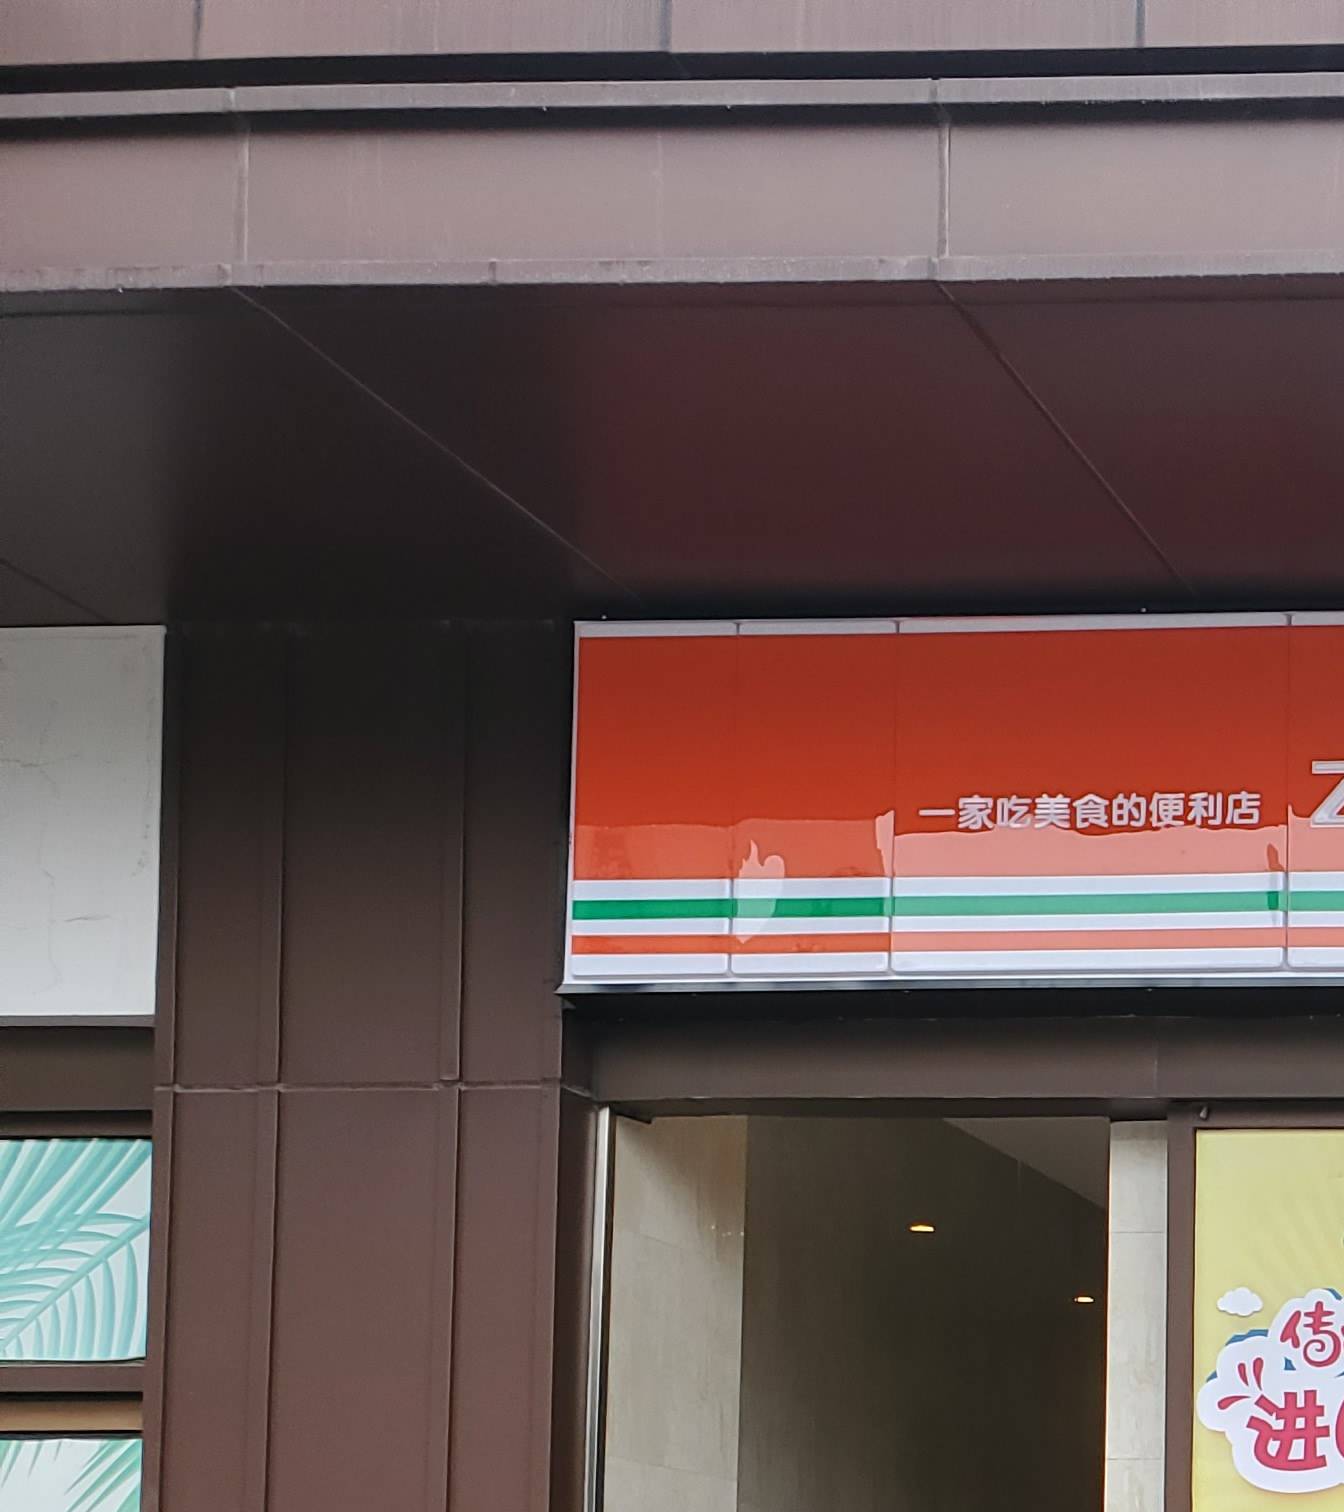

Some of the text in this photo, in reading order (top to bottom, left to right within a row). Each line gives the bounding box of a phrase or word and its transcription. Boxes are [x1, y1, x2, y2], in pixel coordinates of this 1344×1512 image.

[918, 791, 1262, 830] 一家吃美食的便利店
